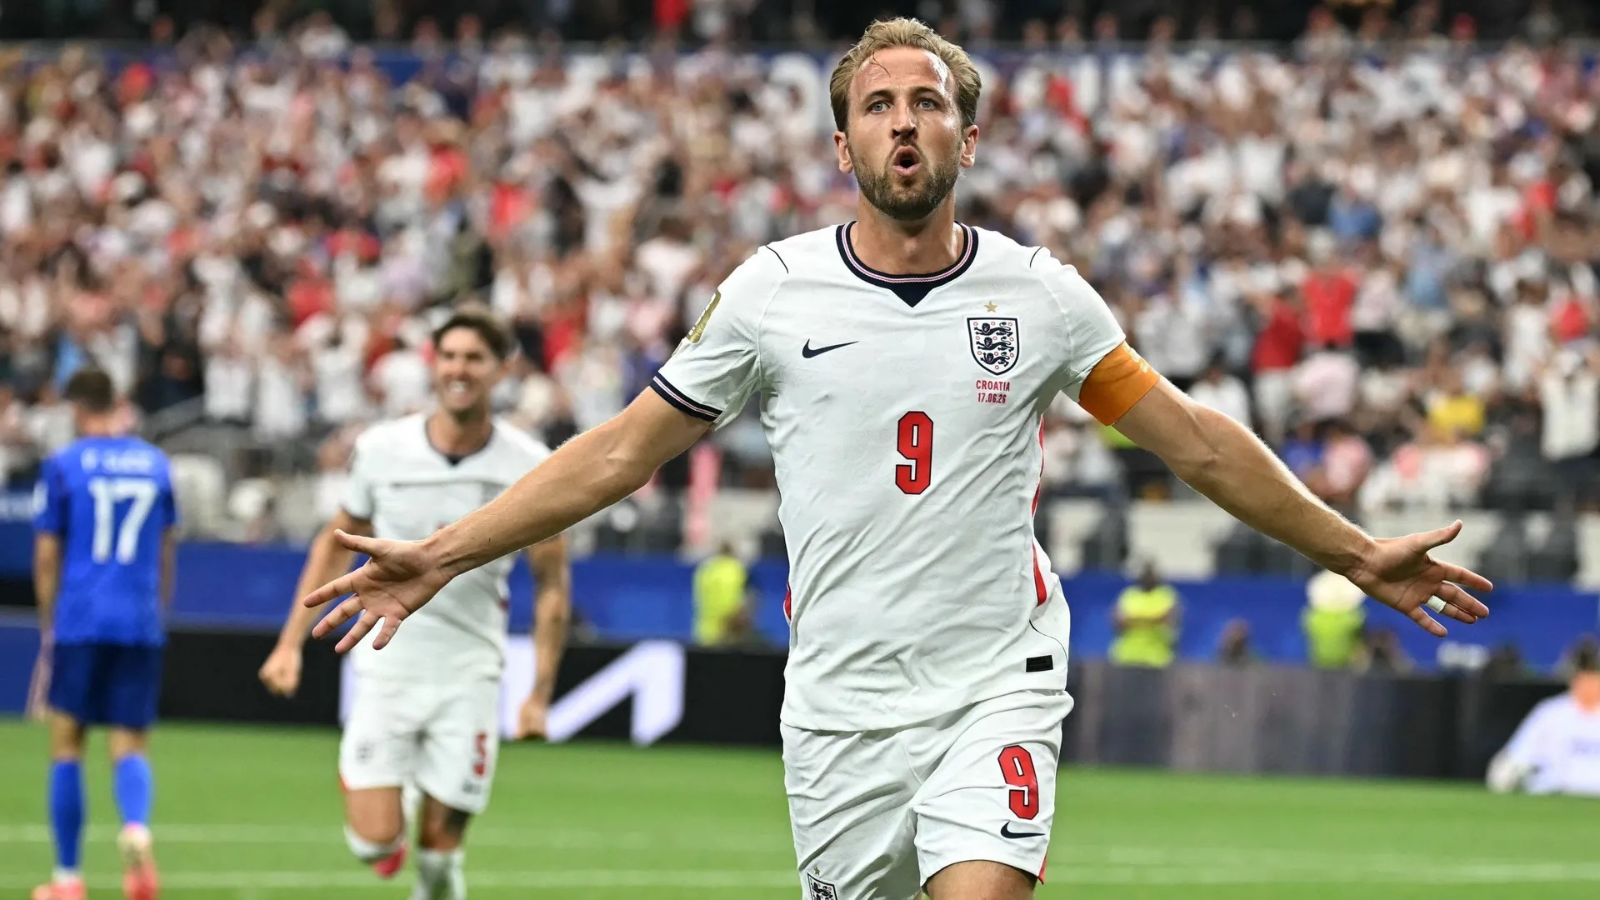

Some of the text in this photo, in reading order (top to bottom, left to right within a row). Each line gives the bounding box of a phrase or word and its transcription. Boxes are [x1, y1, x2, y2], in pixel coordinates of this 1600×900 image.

[975, 379, 1010, 391] CROATIA
[977, 392, 1007, 404] 17.06.26
[895, 411, 934, 495] 9
[87, 476, 158, 565] 17
[997, 744, 1040, 821] 9
